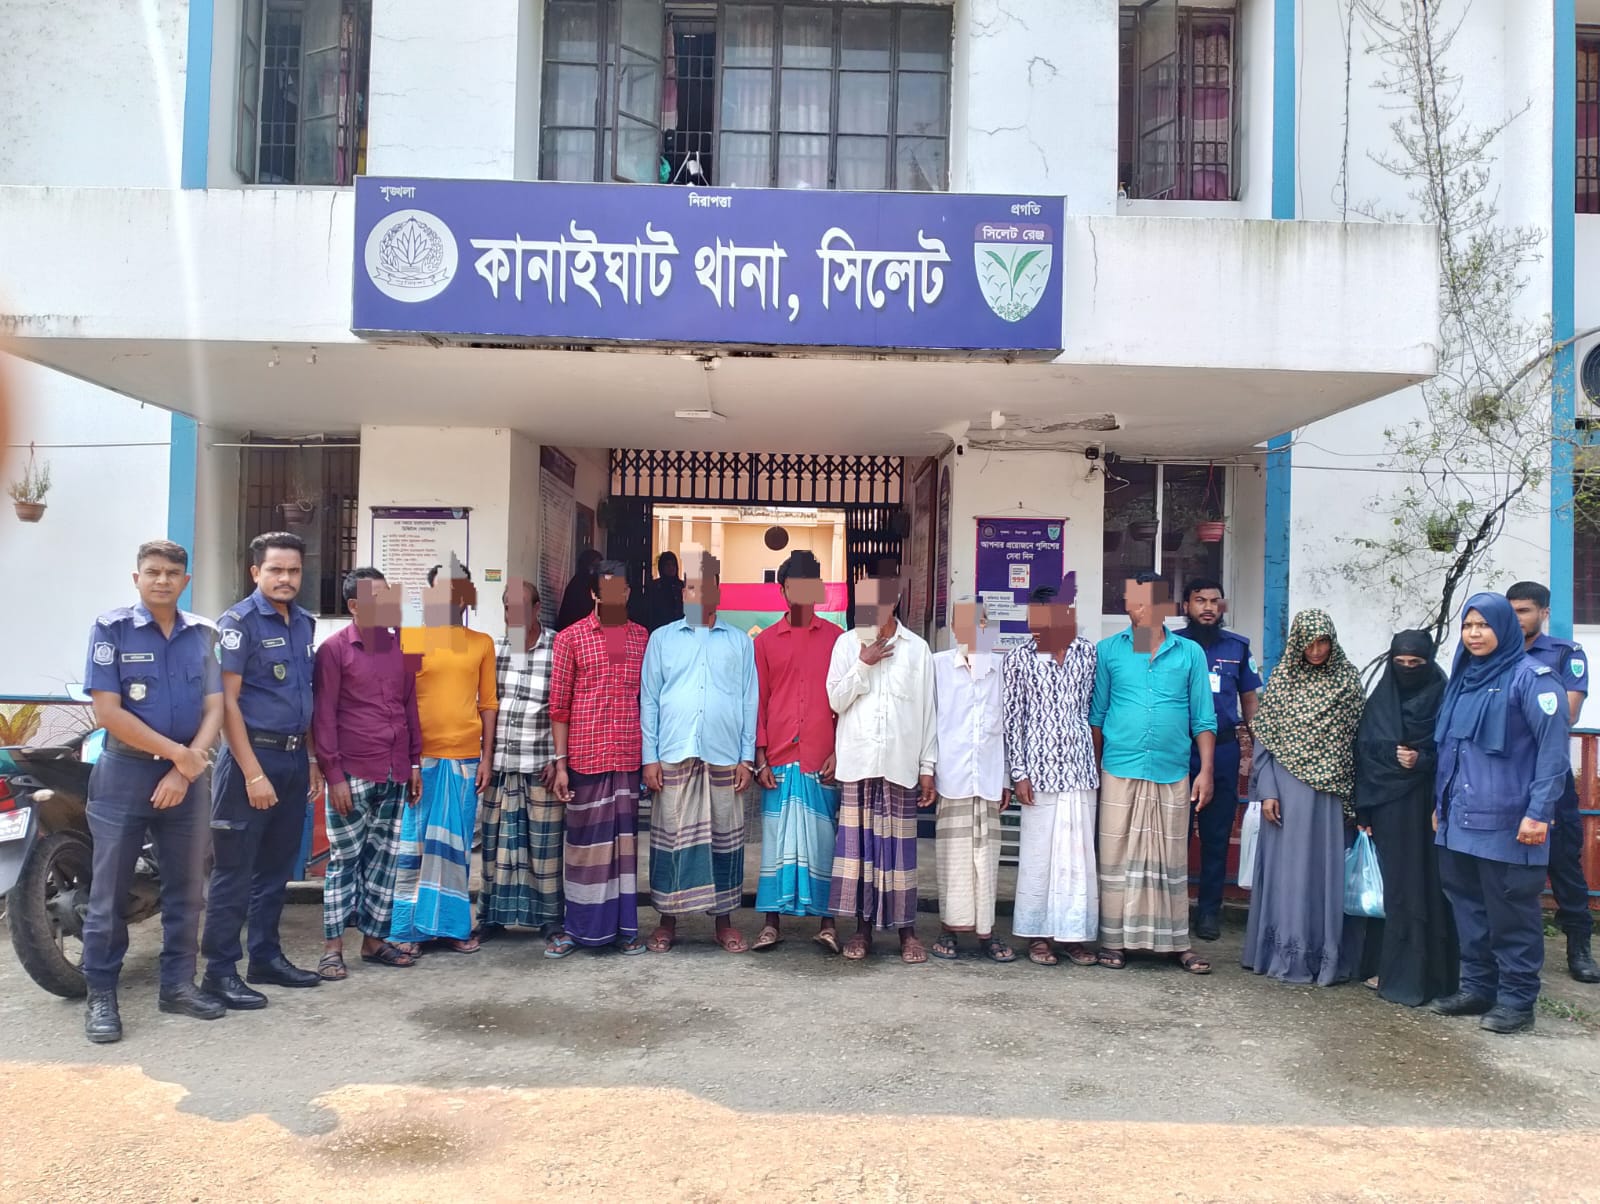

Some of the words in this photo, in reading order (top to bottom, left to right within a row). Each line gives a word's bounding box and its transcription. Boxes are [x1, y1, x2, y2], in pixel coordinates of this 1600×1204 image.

[687, 191, 733, 209] নিরাপত্তা
[1010, 200, 1042, 216] প্রগতি
[982, 225, 1019, 240] সিলেট
[470, 219, 680, 309] কানাইঘাট
[694, 235, 801, 322] থানা,
[816, 226, 952, 313] সিলেট
